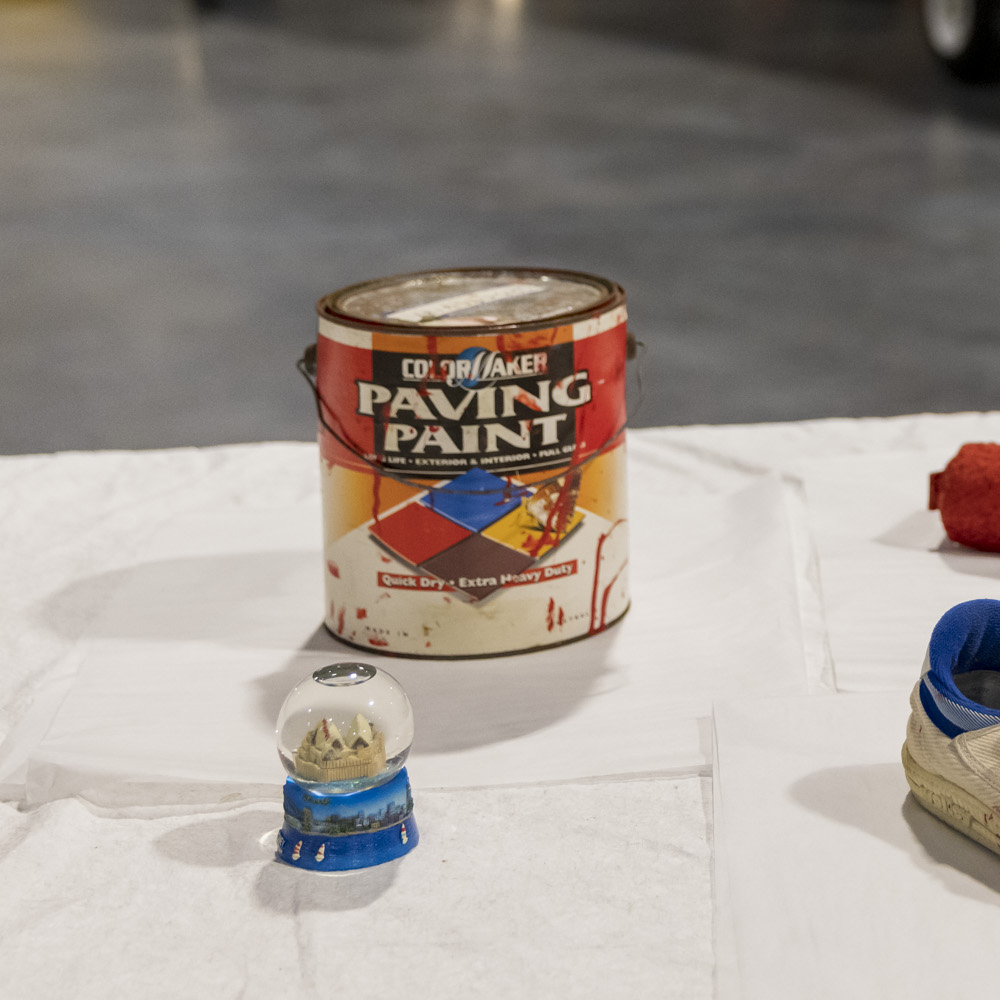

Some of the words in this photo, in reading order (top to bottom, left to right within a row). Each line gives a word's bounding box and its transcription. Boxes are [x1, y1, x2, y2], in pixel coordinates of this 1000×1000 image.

[357, 372, 593, 421] PAVING
[384, 413, 568, 454] PAINT
[388, 456, 407, 465] LIFE
[415, 456, 468, 467] EXTERIOR
[480, 452, 531, 465] INTERIOR
[538, 446, 561, 458] FULL
[381, 573, 417, 587] Quick
[420, 578, 445, 592] Dry
[458, 576, 498, 588] Extra
[500, 570, 544, 585] Heavy
[544, 563, 574, 577] Duty
